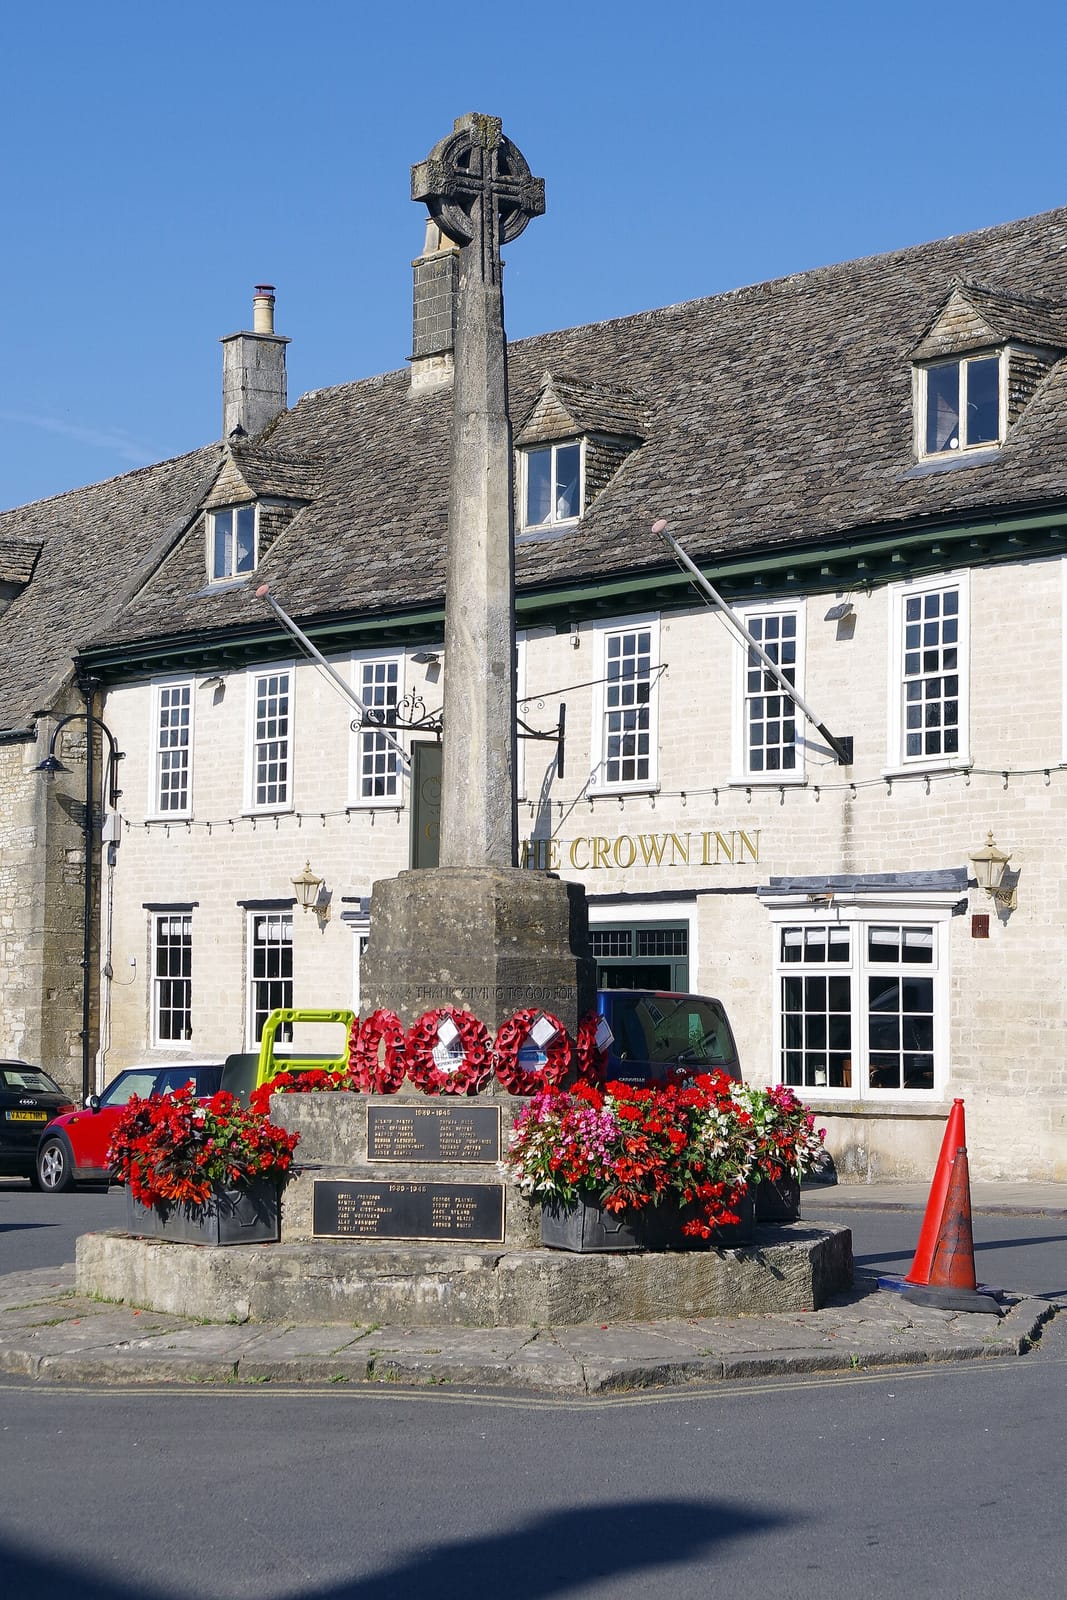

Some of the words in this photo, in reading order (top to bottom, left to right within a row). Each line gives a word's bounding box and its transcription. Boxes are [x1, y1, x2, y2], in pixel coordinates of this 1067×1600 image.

[520, 838, 561, 870] HE
[569, 832, 691, 870] CROWN
[701, 829, 762, 866] INN
[507, 987, 523, 999] TO
[526, 987, 551, 1000] GOD
[554, 987, 573, 1000] FOR
